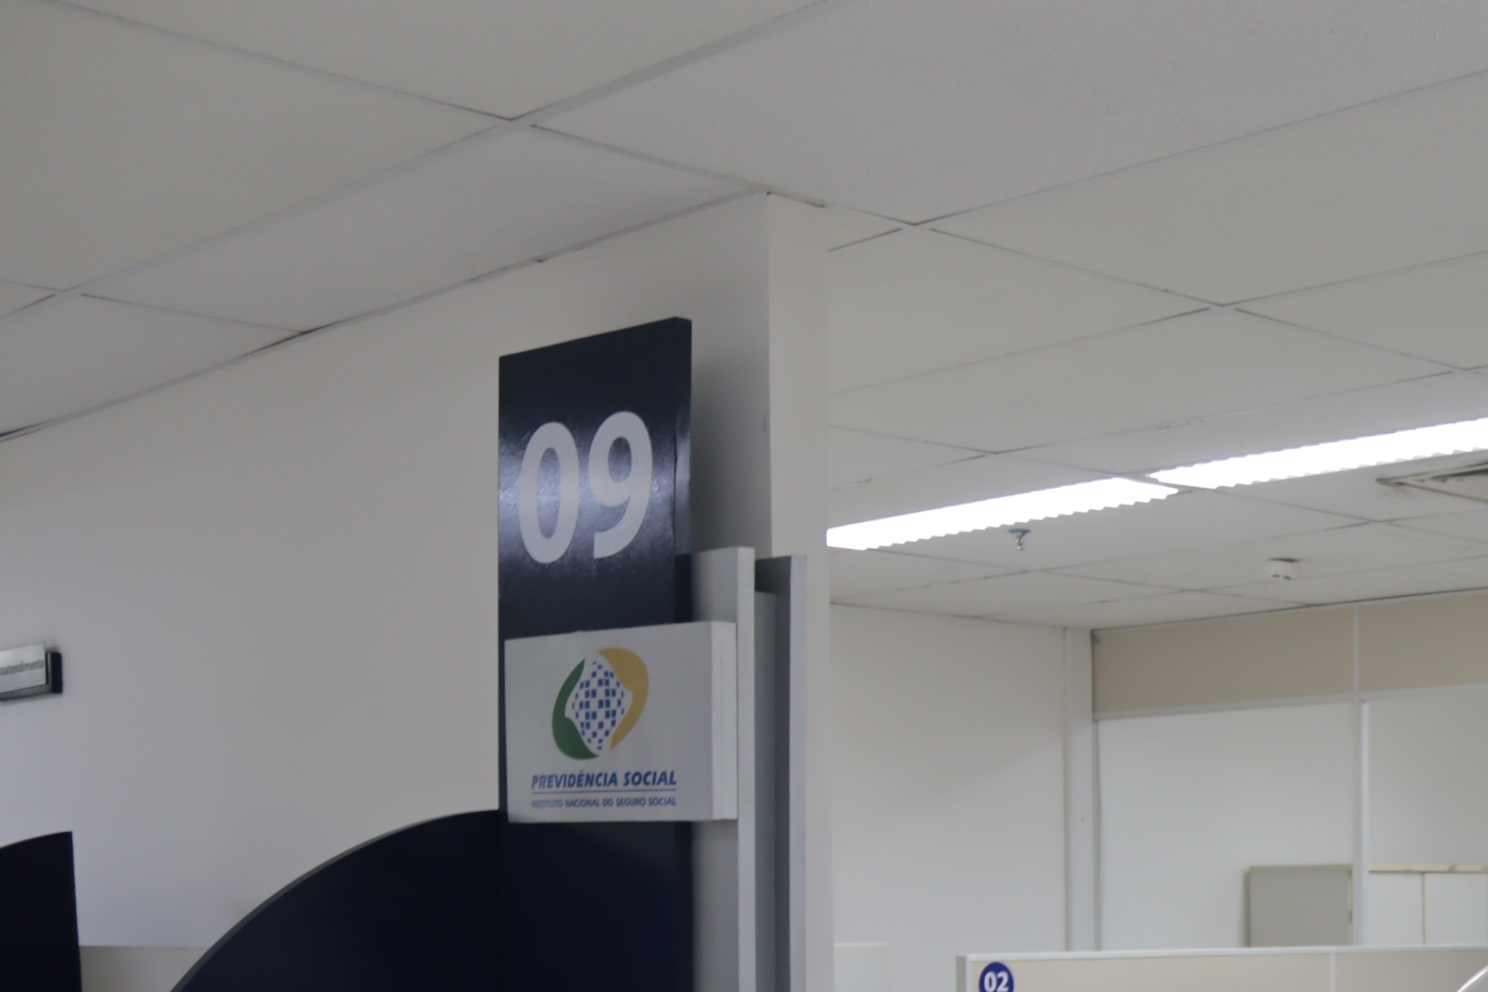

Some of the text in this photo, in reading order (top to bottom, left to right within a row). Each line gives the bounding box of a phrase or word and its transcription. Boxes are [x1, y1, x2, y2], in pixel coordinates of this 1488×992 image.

[518, 411, 653, 564] 09
[623, 770, 677, 787] SOCIAL
[565, 799, 599, 808] NACIONAL
[602, 798, 614, 807] DO
[616, 797, 646, 807] SEGURO
[649, 796, 677, 806] SOCIAL
[984, 971, 1009, 992] 02
